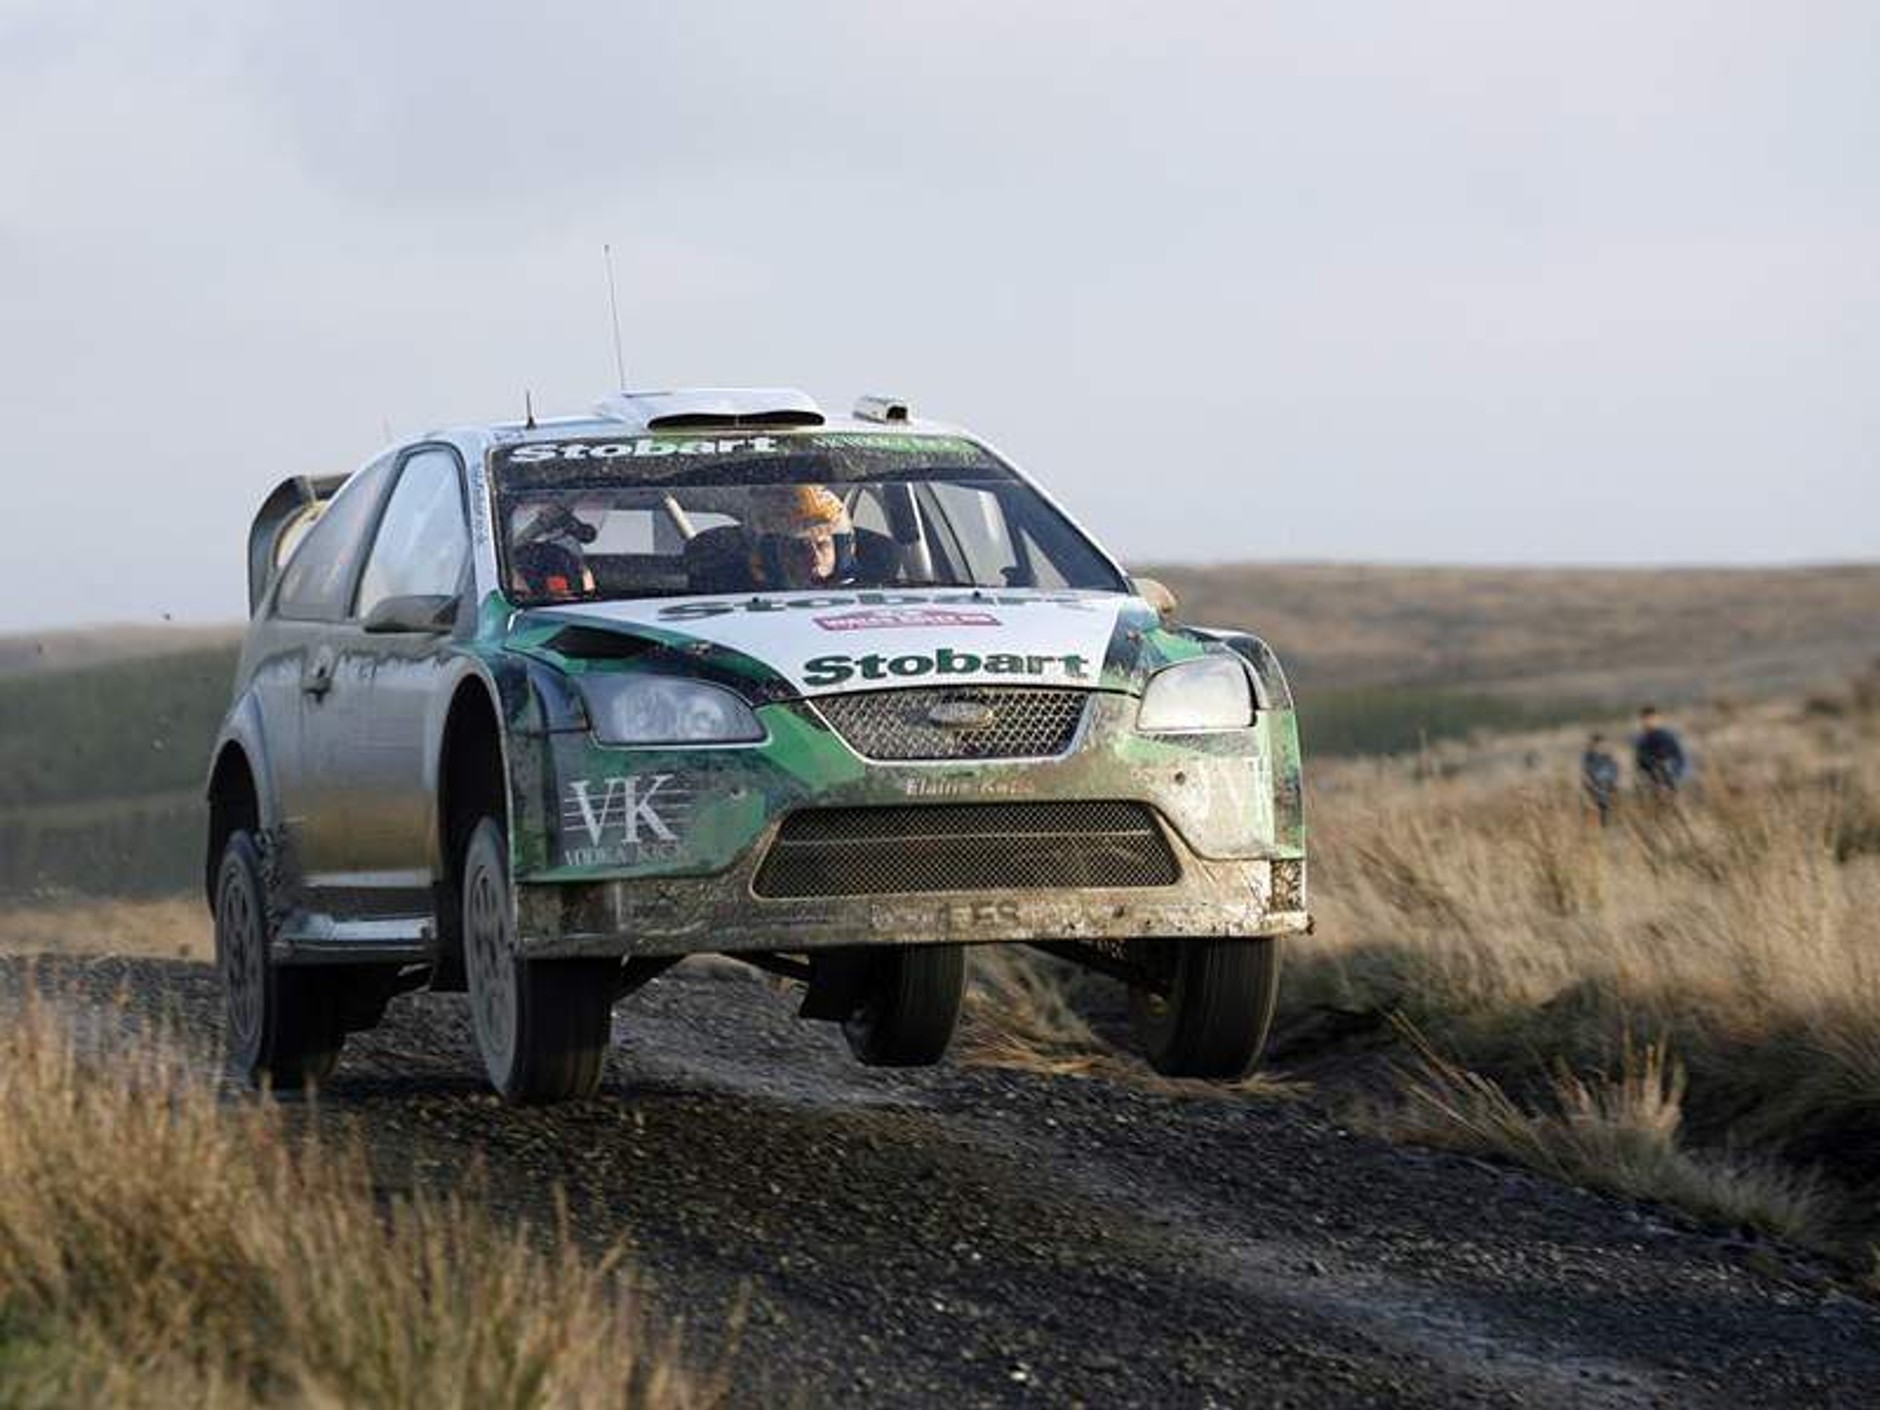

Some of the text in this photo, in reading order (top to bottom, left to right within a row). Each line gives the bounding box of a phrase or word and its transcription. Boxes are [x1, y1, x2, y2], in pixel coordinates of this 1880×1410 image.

[511, 437, 778, 462] Stobart
[803, 649, 1089, 687] Stobart
[568, 774, 680, 847] VK
